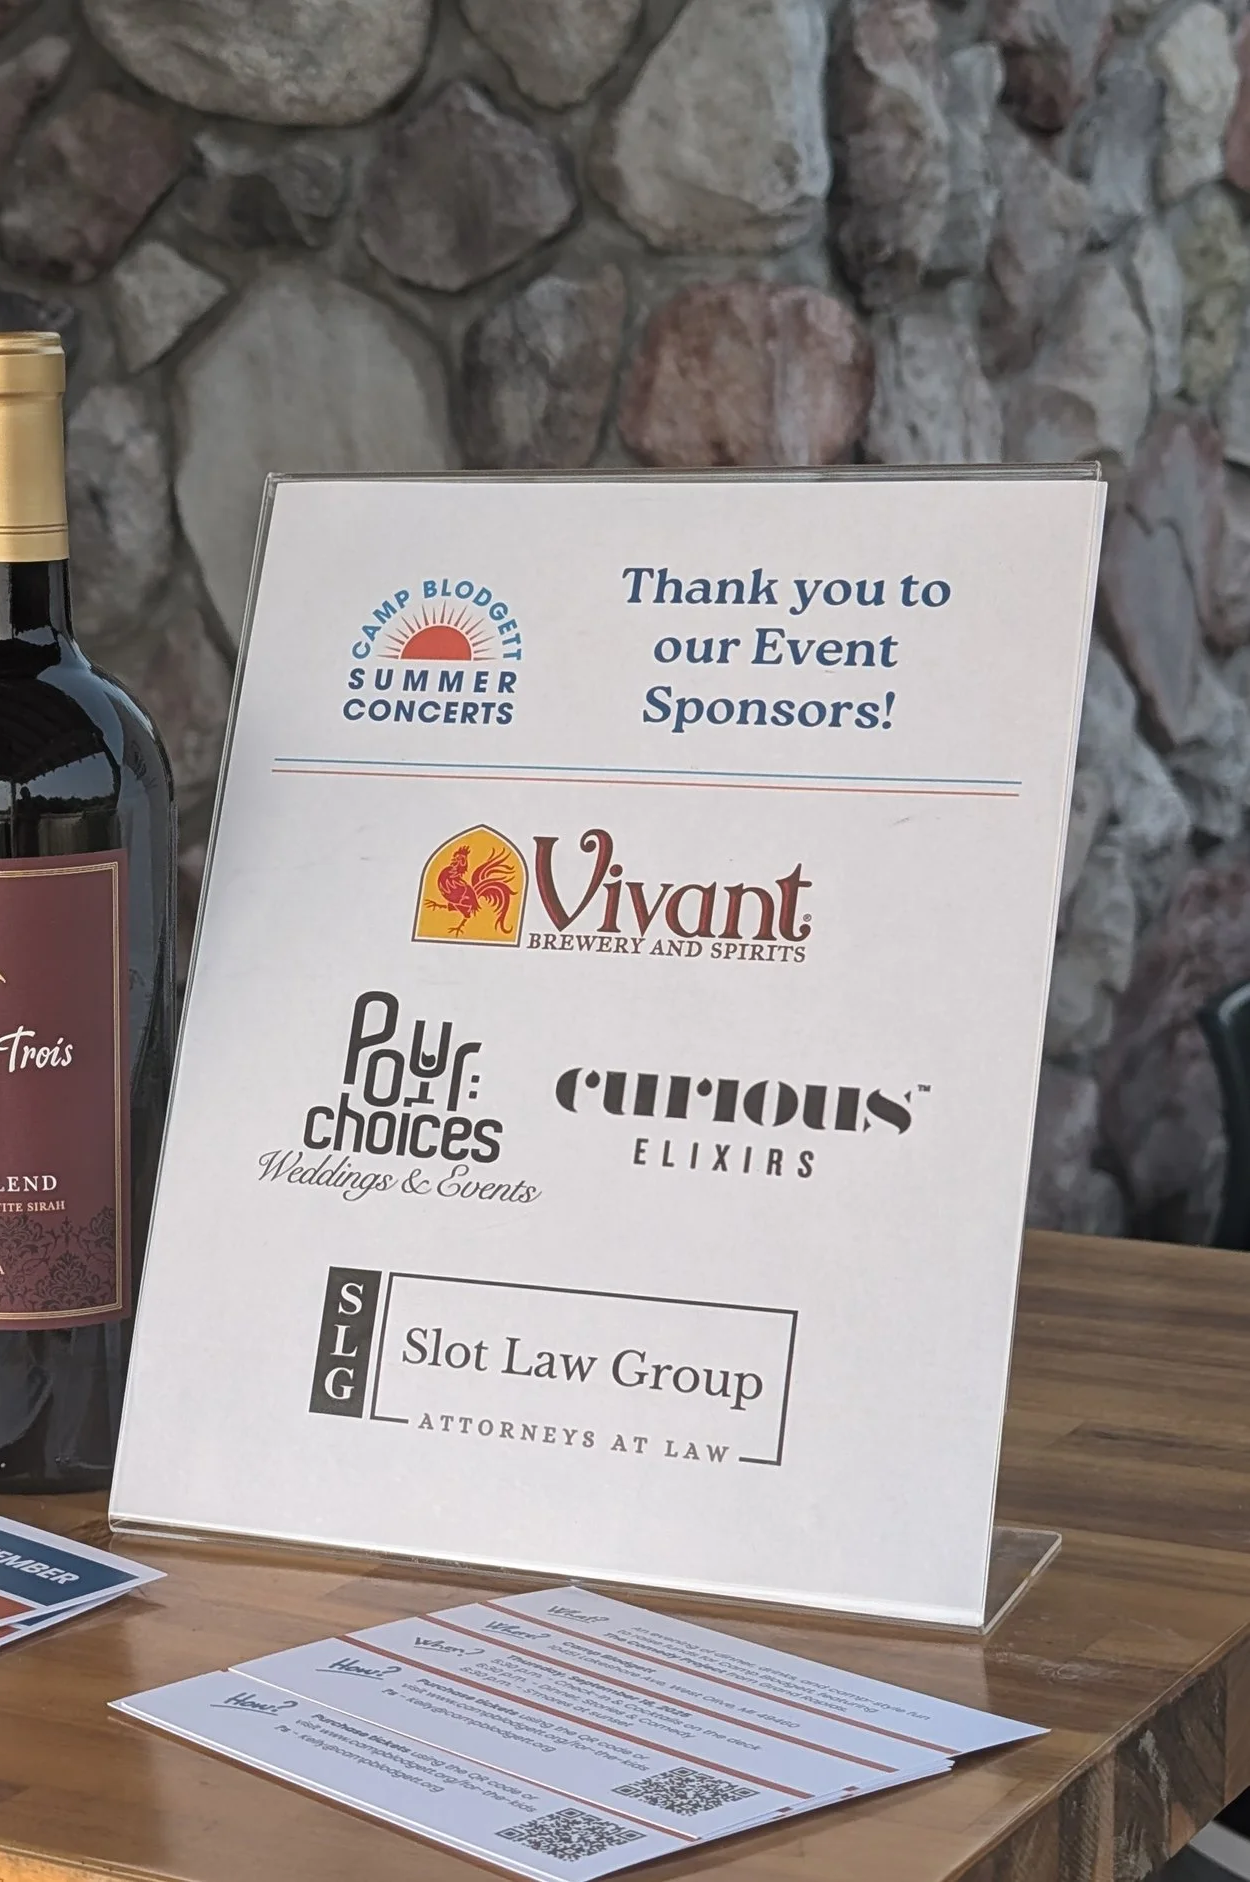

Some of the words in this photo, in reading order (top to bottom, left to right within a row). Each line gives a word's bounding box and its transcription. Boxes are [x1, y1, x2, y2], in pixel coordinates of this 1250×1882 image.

[622, 567, 779, 605] Thank
[789, 578, 885, 615] you
[900, 575, 951, 608] to
[352, 590, 410, 659] CAMP
[423, 579, 522, 660] BLODGETT
[653, 636, 741, 664] our
[751, 627, 899, 668] Event
[348, 668, 517, 693] SUMMER
[343, 699, 514, 725] CONCERTS
[642, 686, 896, 733] Sponsors!
[533, 828, 813, 942] Vivant
[526, 933, 645, 955] BREWERY
[650, 939, 703, 958] AND
[710, 943, 807, 963] SPIRITS
[303, 1092, 503, 1163] choices
[258, 1150, 399, 1202] Weddings
[401, 1168, 432, 1194] &
[436, 1164, 542, 1203] Events
[633, 1138, 815, 1179] ELIXIRS
[27, 1200, 66, 1211] SIRAH
[402, 1326, 490, 1371] Slot
[501, 1337, 599, 1383] Law
[612, 1349, 764, 1411] Group
[417, 1412, 596, 1448] ATTORNEYS
[611, 1434, 649, 1454] AT
[665, 1440, 731, 1463] LAW
[485, 1620, 551, 1640] Where?
[548, 1604, 610, 1623] What?
[328, 1657, 402, 1677] How?
[414, 1636, 485, 1657] When?
[223, 1691, 298, 1712] How?
[416, 1678, 475, 1700] Purchase
[474, 1698, 519, 1715] tickets
[518, 1714, 554, 1728] using
[553, 1726, 577, 1735] the
[597, 1741, 632, 1754] code
[295, 1719, 321, 1730] visit
[310, 1713, 369, 1737] Purchase
[367, 1735, 411, 1752] tickets
[410, 1751, 446, 1766] using
[444, 1764, 468, 1774] the
[486, 1780, 522, 1794] code
